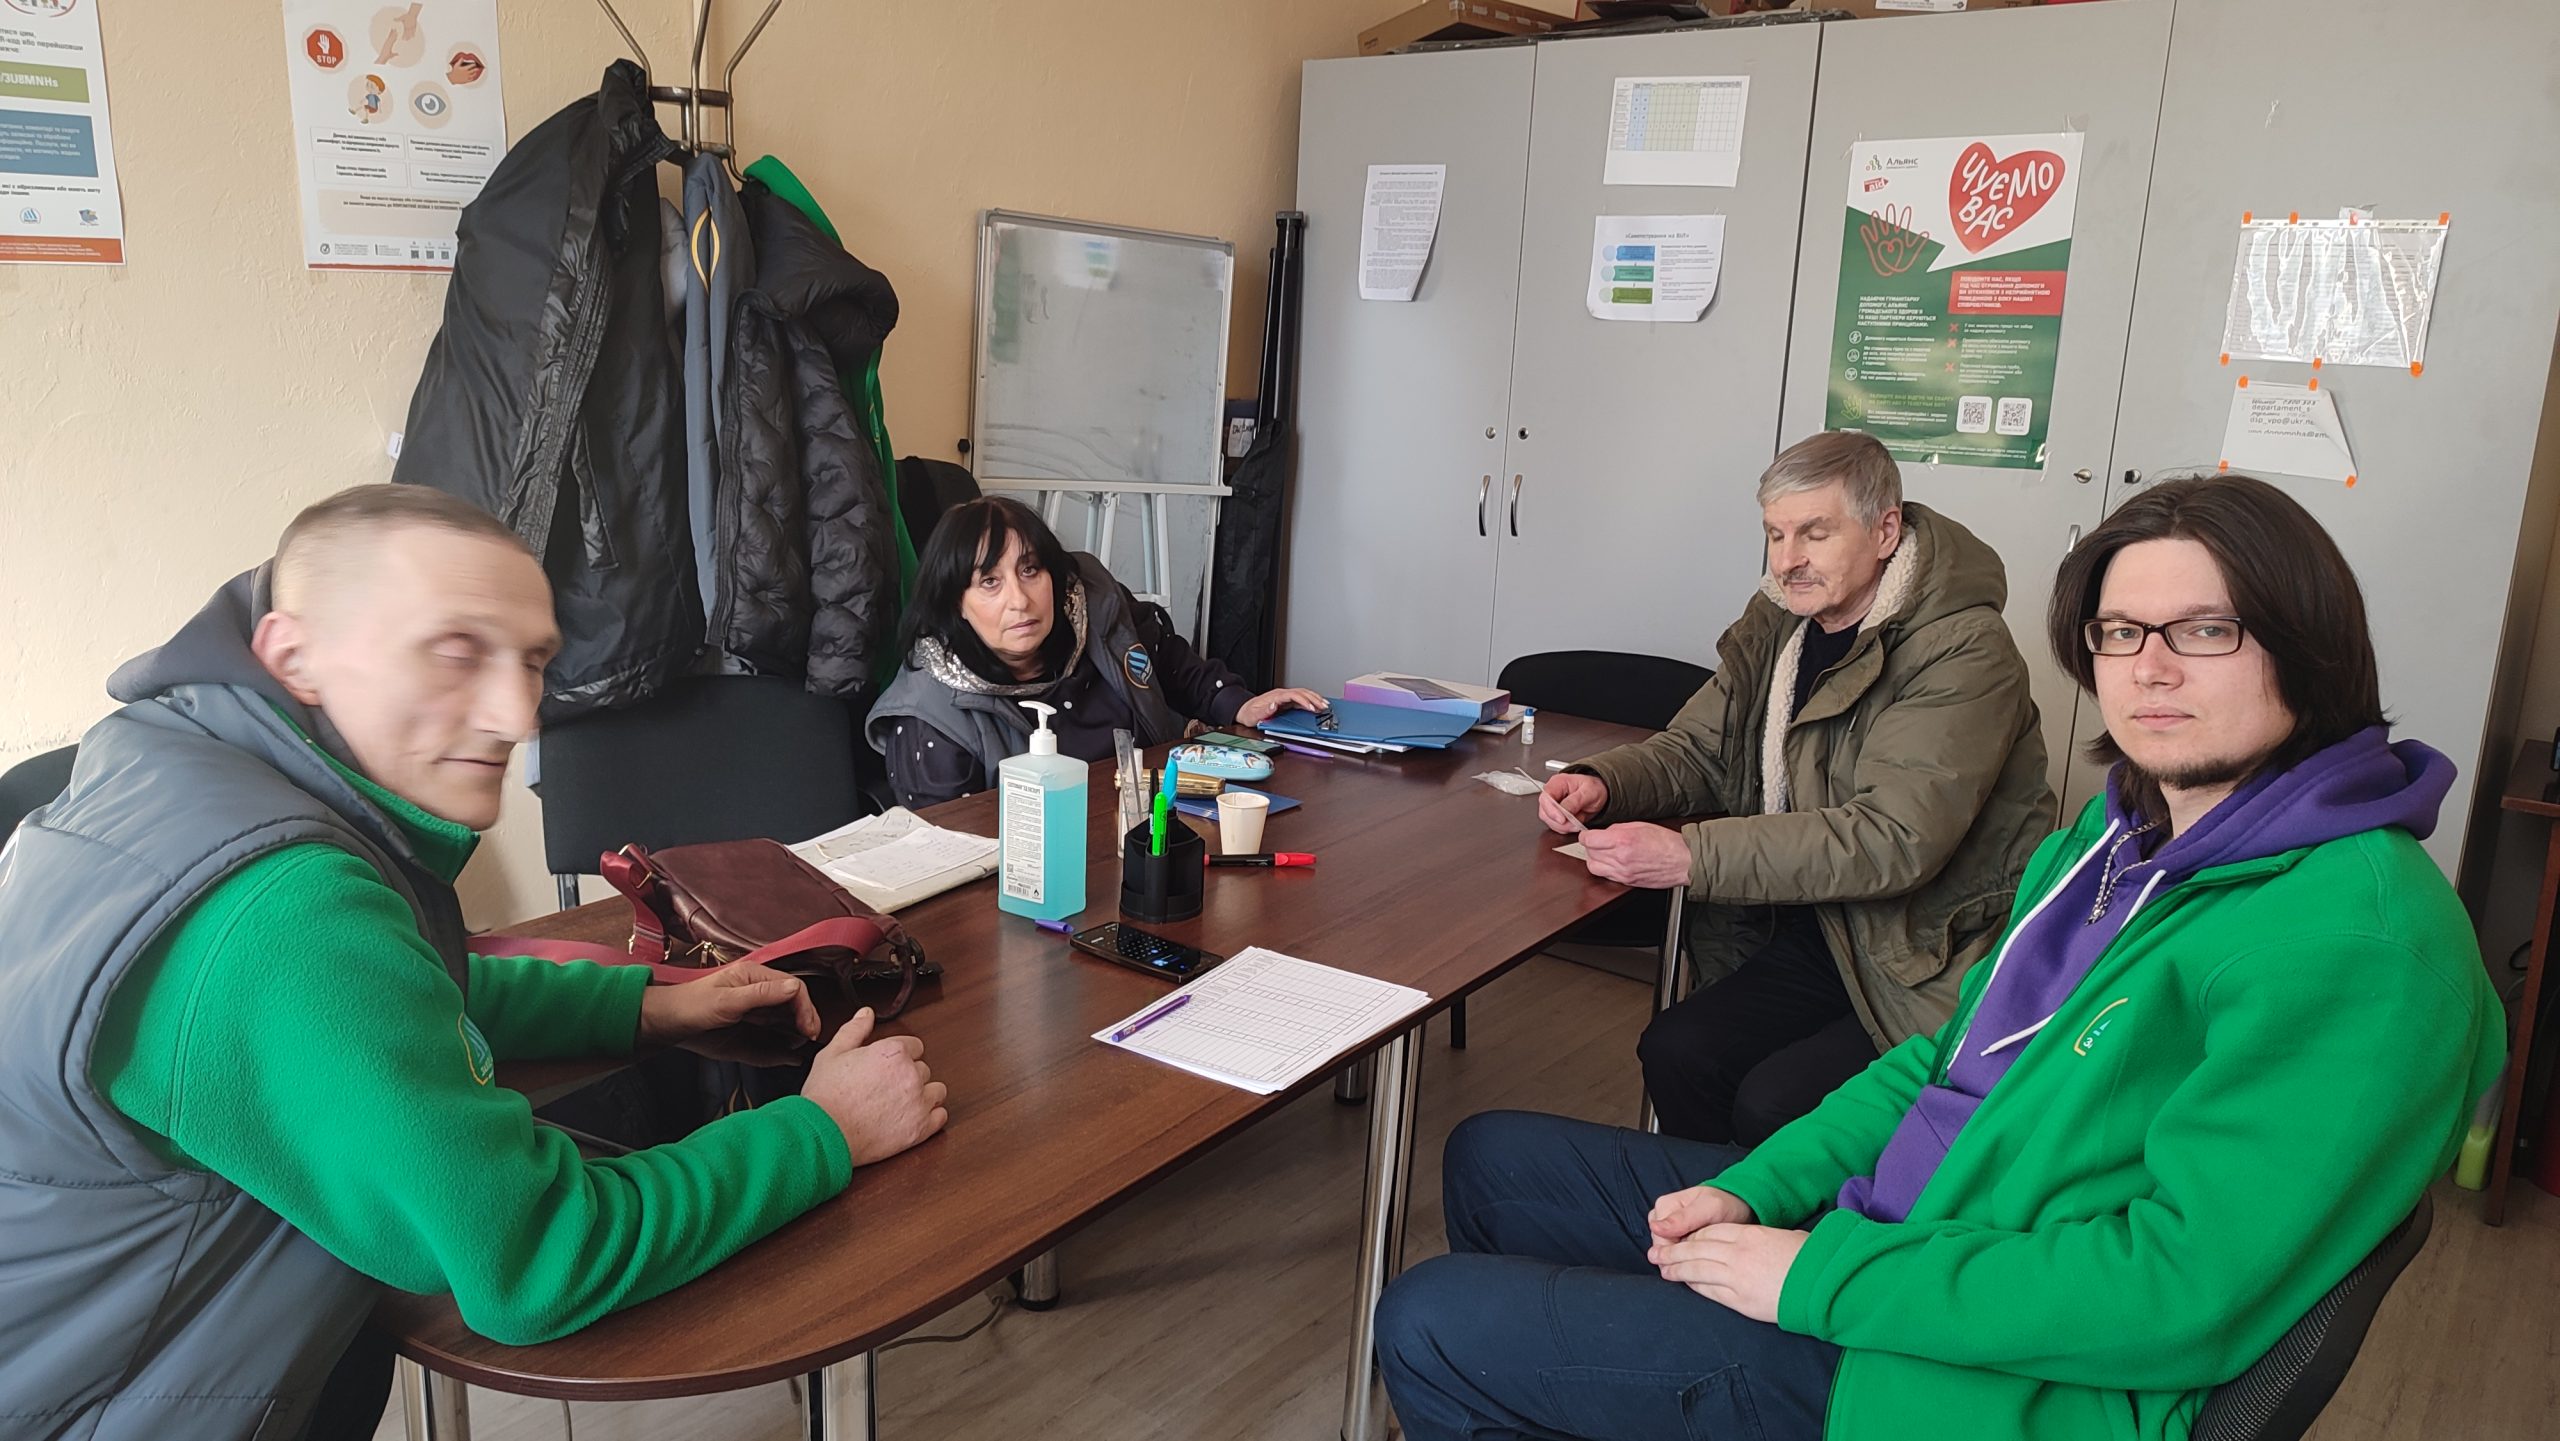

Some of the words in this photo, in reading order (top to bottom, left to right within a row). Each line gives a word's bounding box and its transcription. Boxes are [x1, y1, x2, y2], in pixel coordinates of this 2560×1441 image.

[317, 54, 337, 65] STOP
[1886, 157, 1919, 166] Альянс
[1961, 151, 2055, 206] ЧУЄМО
[1958, 195, 2014, 239] ВАС
